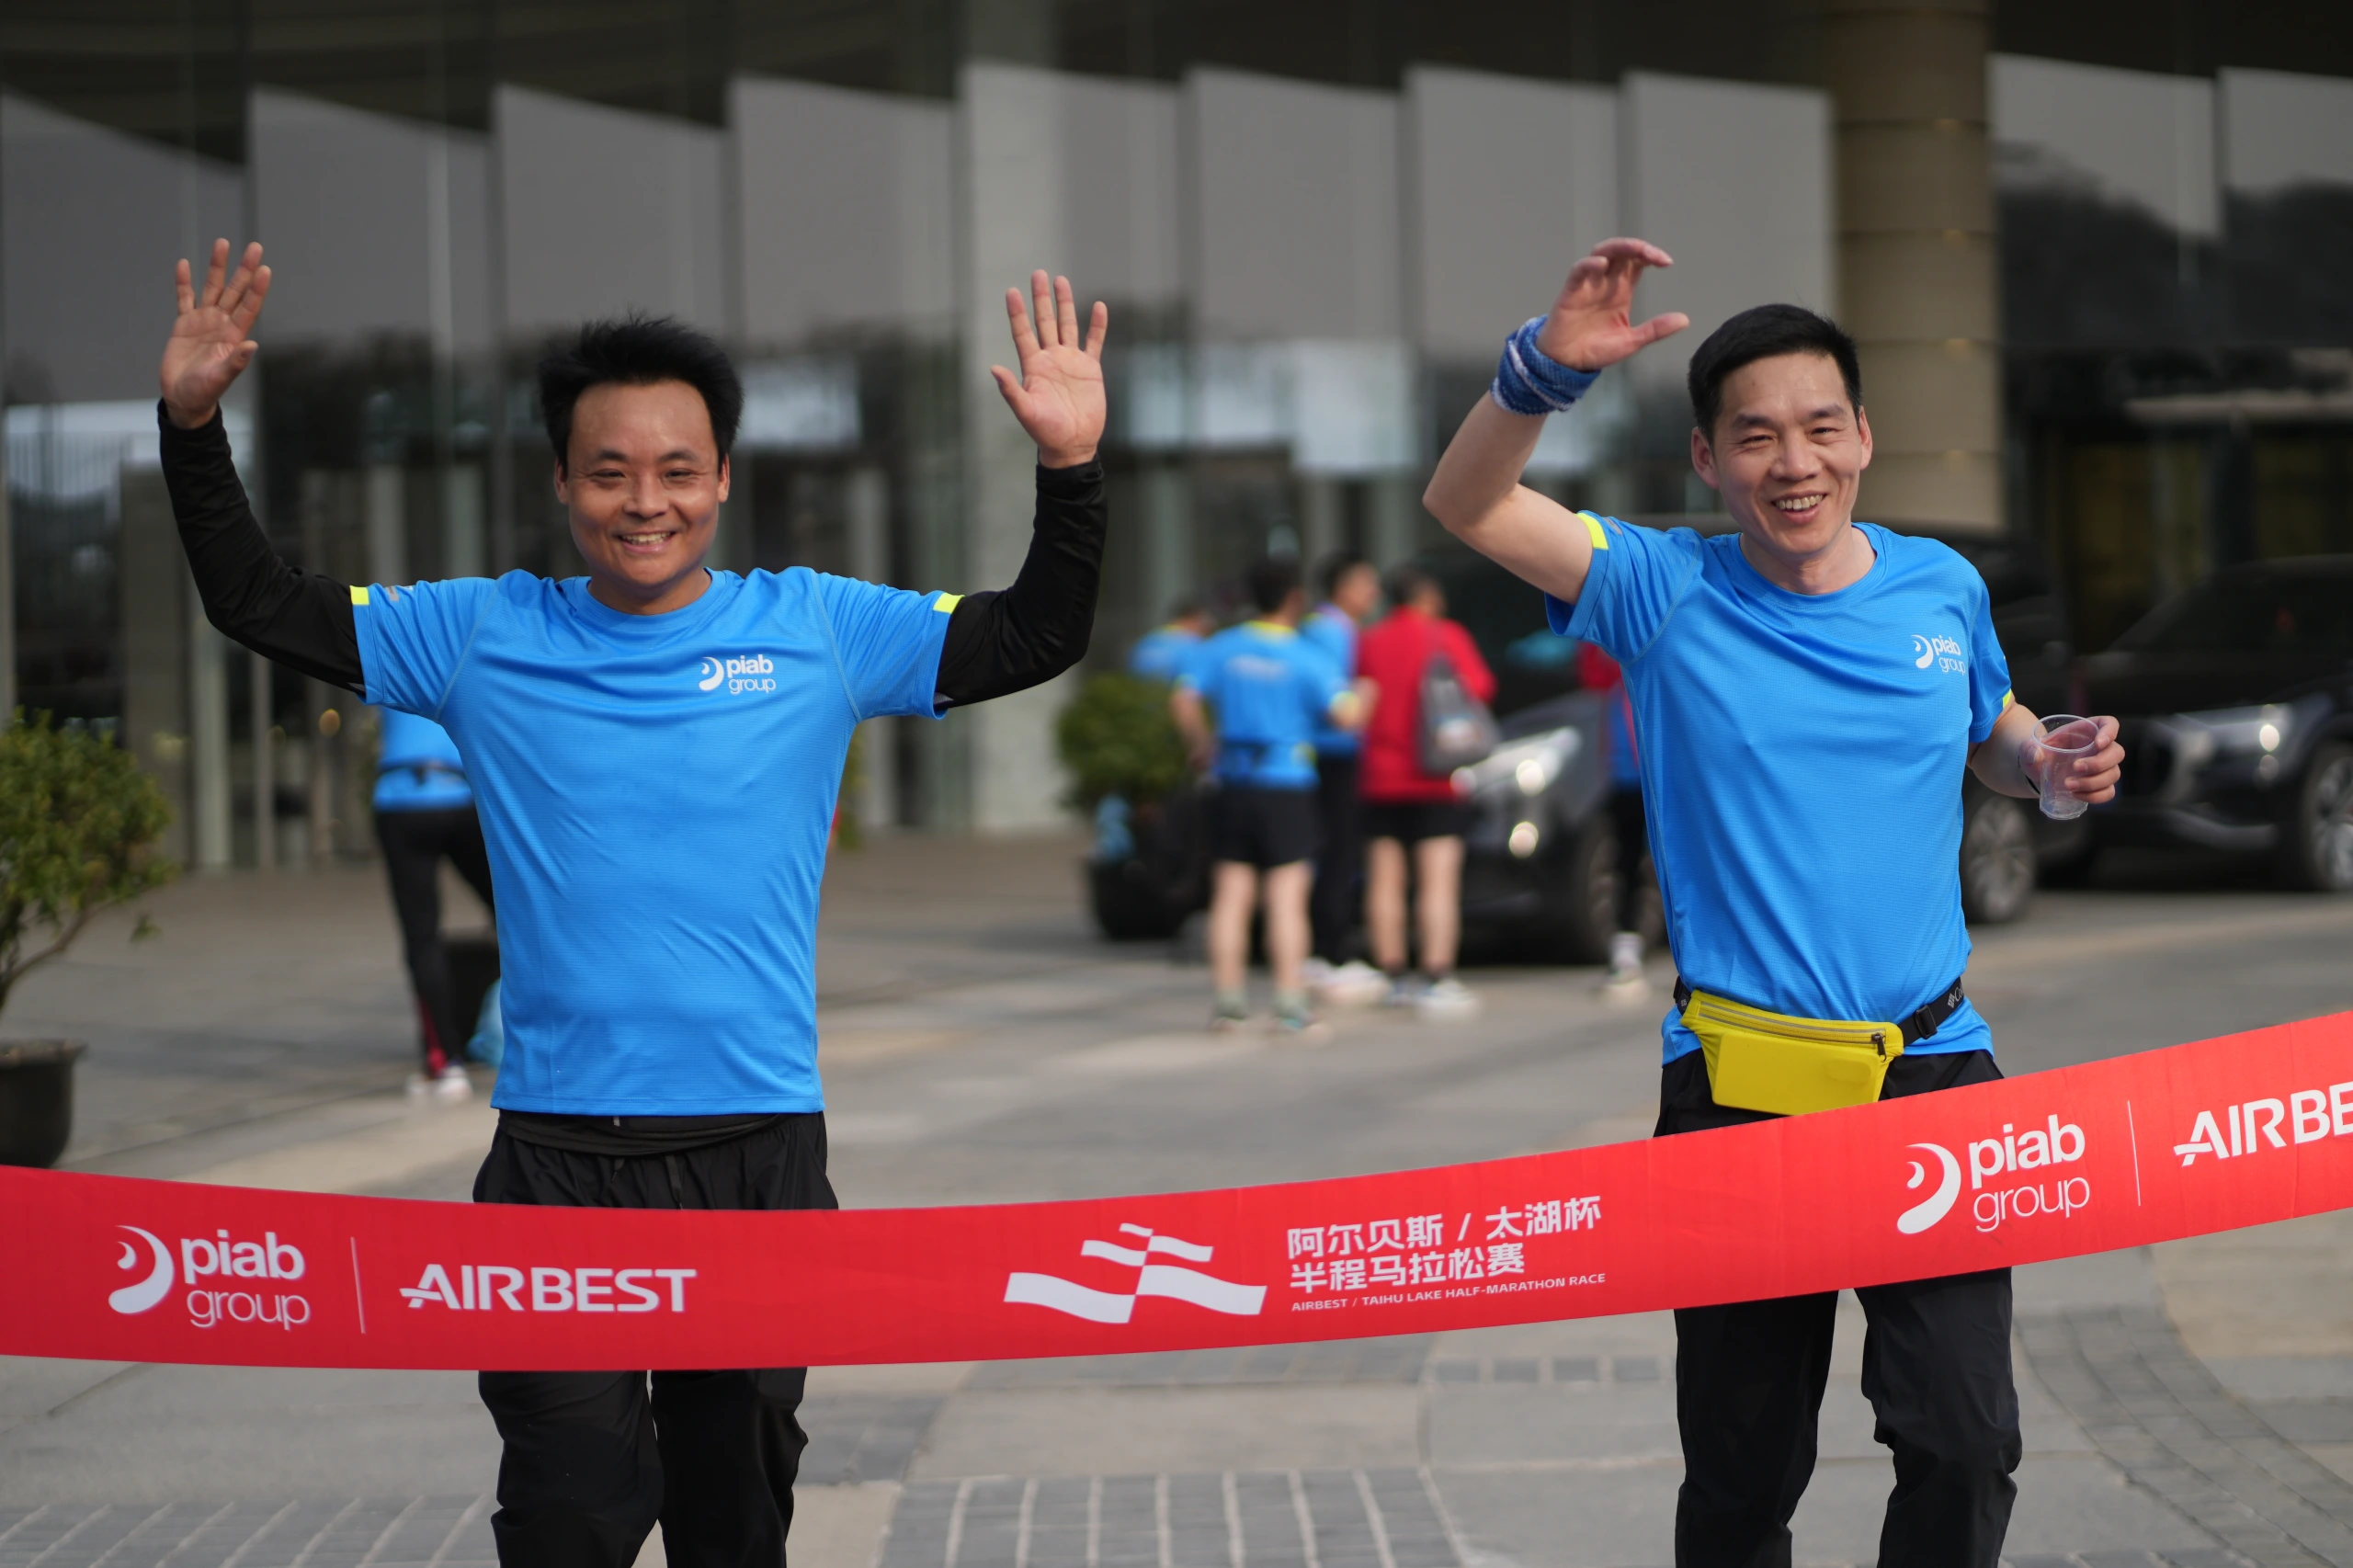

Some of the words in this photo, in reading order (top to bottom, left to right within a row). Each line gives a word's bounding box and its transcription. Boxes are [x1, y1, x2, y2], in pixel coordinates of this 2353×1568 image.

[726, 653, 774, 678] piab
[1931, 634, 1961, 656] piab
[1938, 656, 1966, 676] group
[728, 678, 777, 695] group
[1969, 1114, 2086, 1188] piab
[1973, 1176, 2090, 1233] group
[1287, 1213, 1444, 1260] 阿尔贝斯
[1457, 1212, 1472, 1242] /
[1485, 1195, 1602, 1241] 太湖杯
[182, 1229, 305, 1284] piab
[1290, 1242, 1525, 1294] 半程马拉松赛
[187, 1290, 310, 1330] group
[399, 1264, 697, 1312] AIRBEST
[1291, 1298, 1348, 1312] AIRBEST
[1361, 1293, 1404, 1306] TAIHU
[1407, 1290, 1442, 1302] LAKE
[1446, 1278, 1565, 1298] HALF-MARATHON
[1569, 1273, 1606, 1286] RACE
